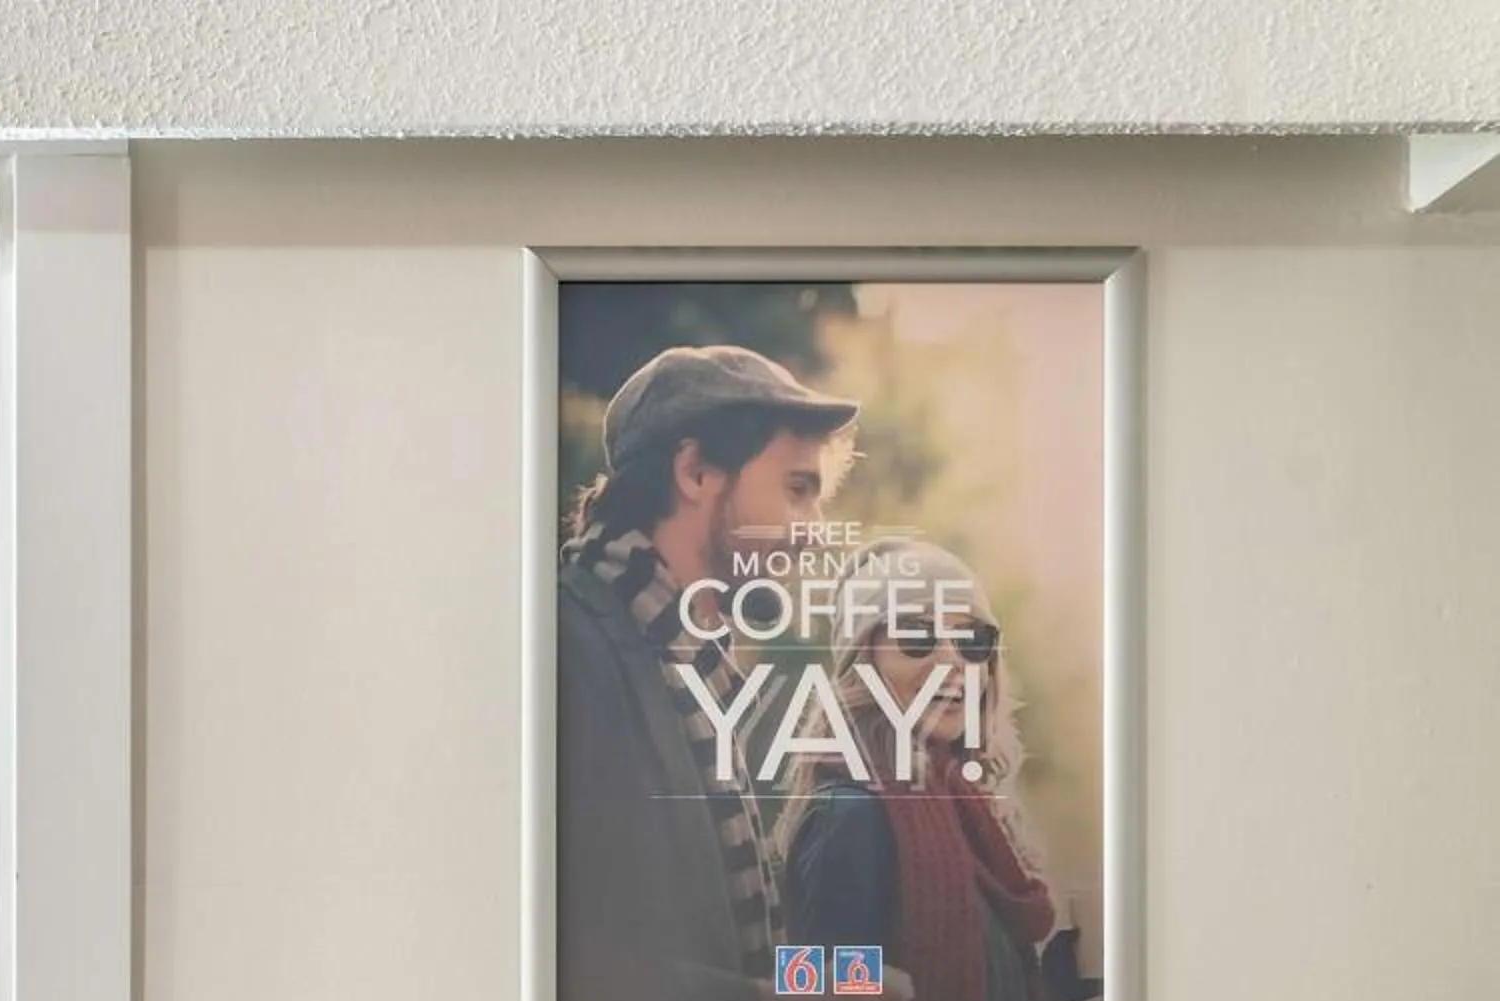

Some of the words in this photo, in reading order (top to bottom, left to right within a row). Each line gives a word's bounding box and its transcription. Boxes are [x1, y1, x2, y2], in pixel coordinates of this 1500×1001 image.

[790, 521, 862, 546] FREE
[732, 551, 922, 577] MORNING
[679, 578, 975, 641] COFFEE
[675, 663, 983, 782] YAY!
[784, 948, 818, 992] 6
